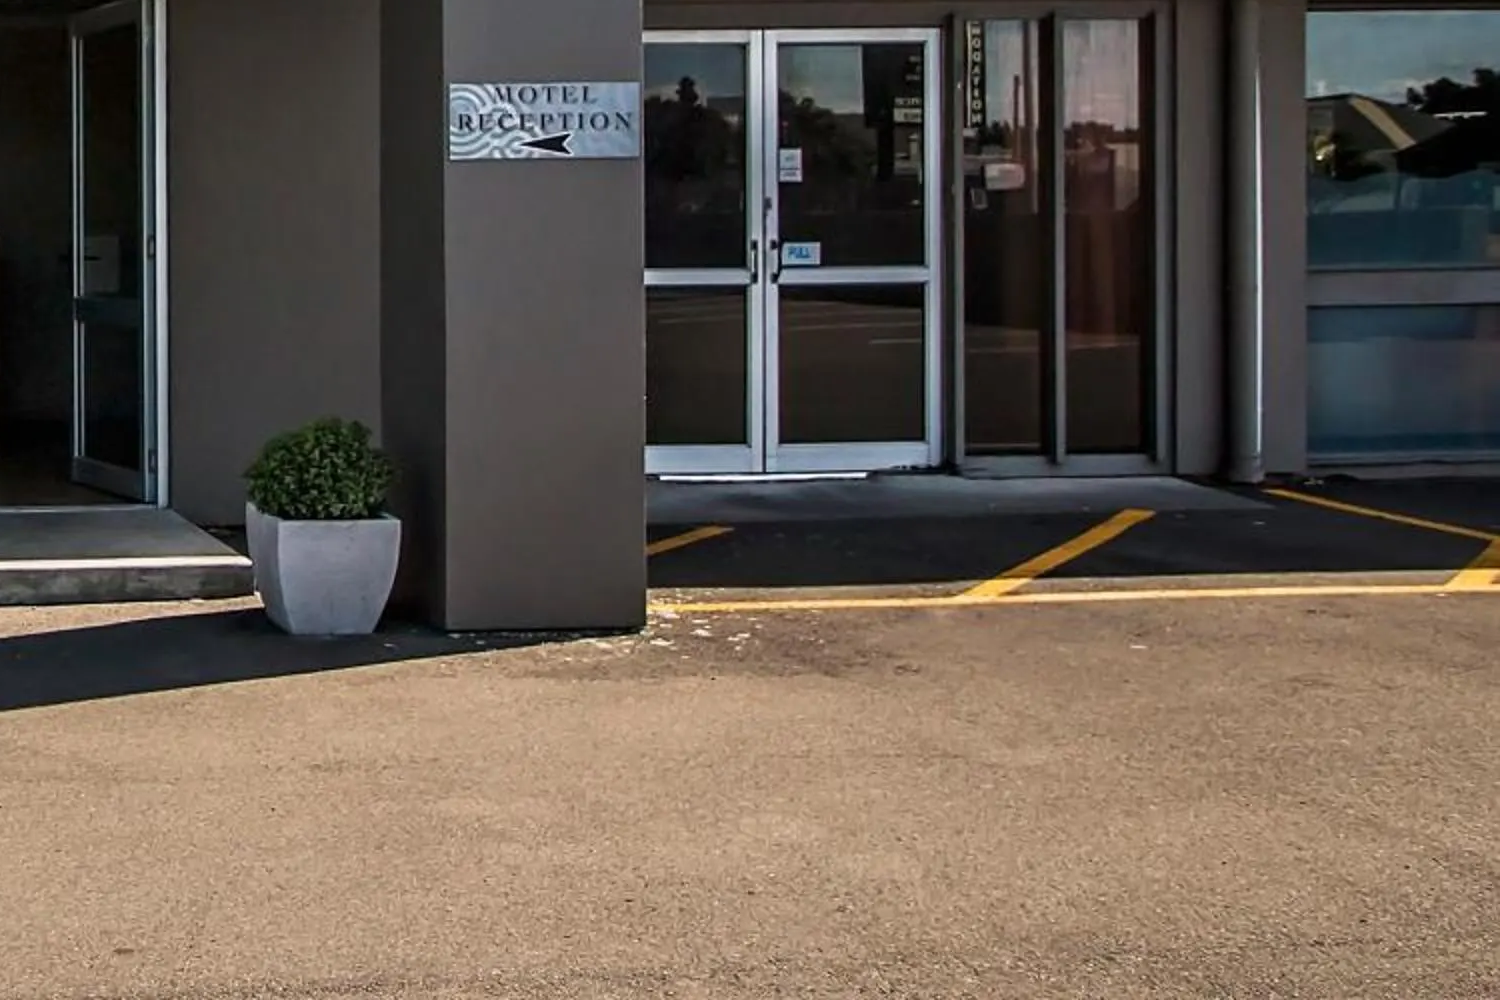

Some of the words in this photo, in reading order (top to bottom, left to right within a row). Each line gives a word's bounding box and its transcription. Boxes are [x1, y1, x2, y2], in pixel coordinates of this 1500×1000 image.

[494, 85, 599, 105] MOTEL
[457, 111, 633, 132] RECEPTION
[787, 247, 811, 259] PULL
